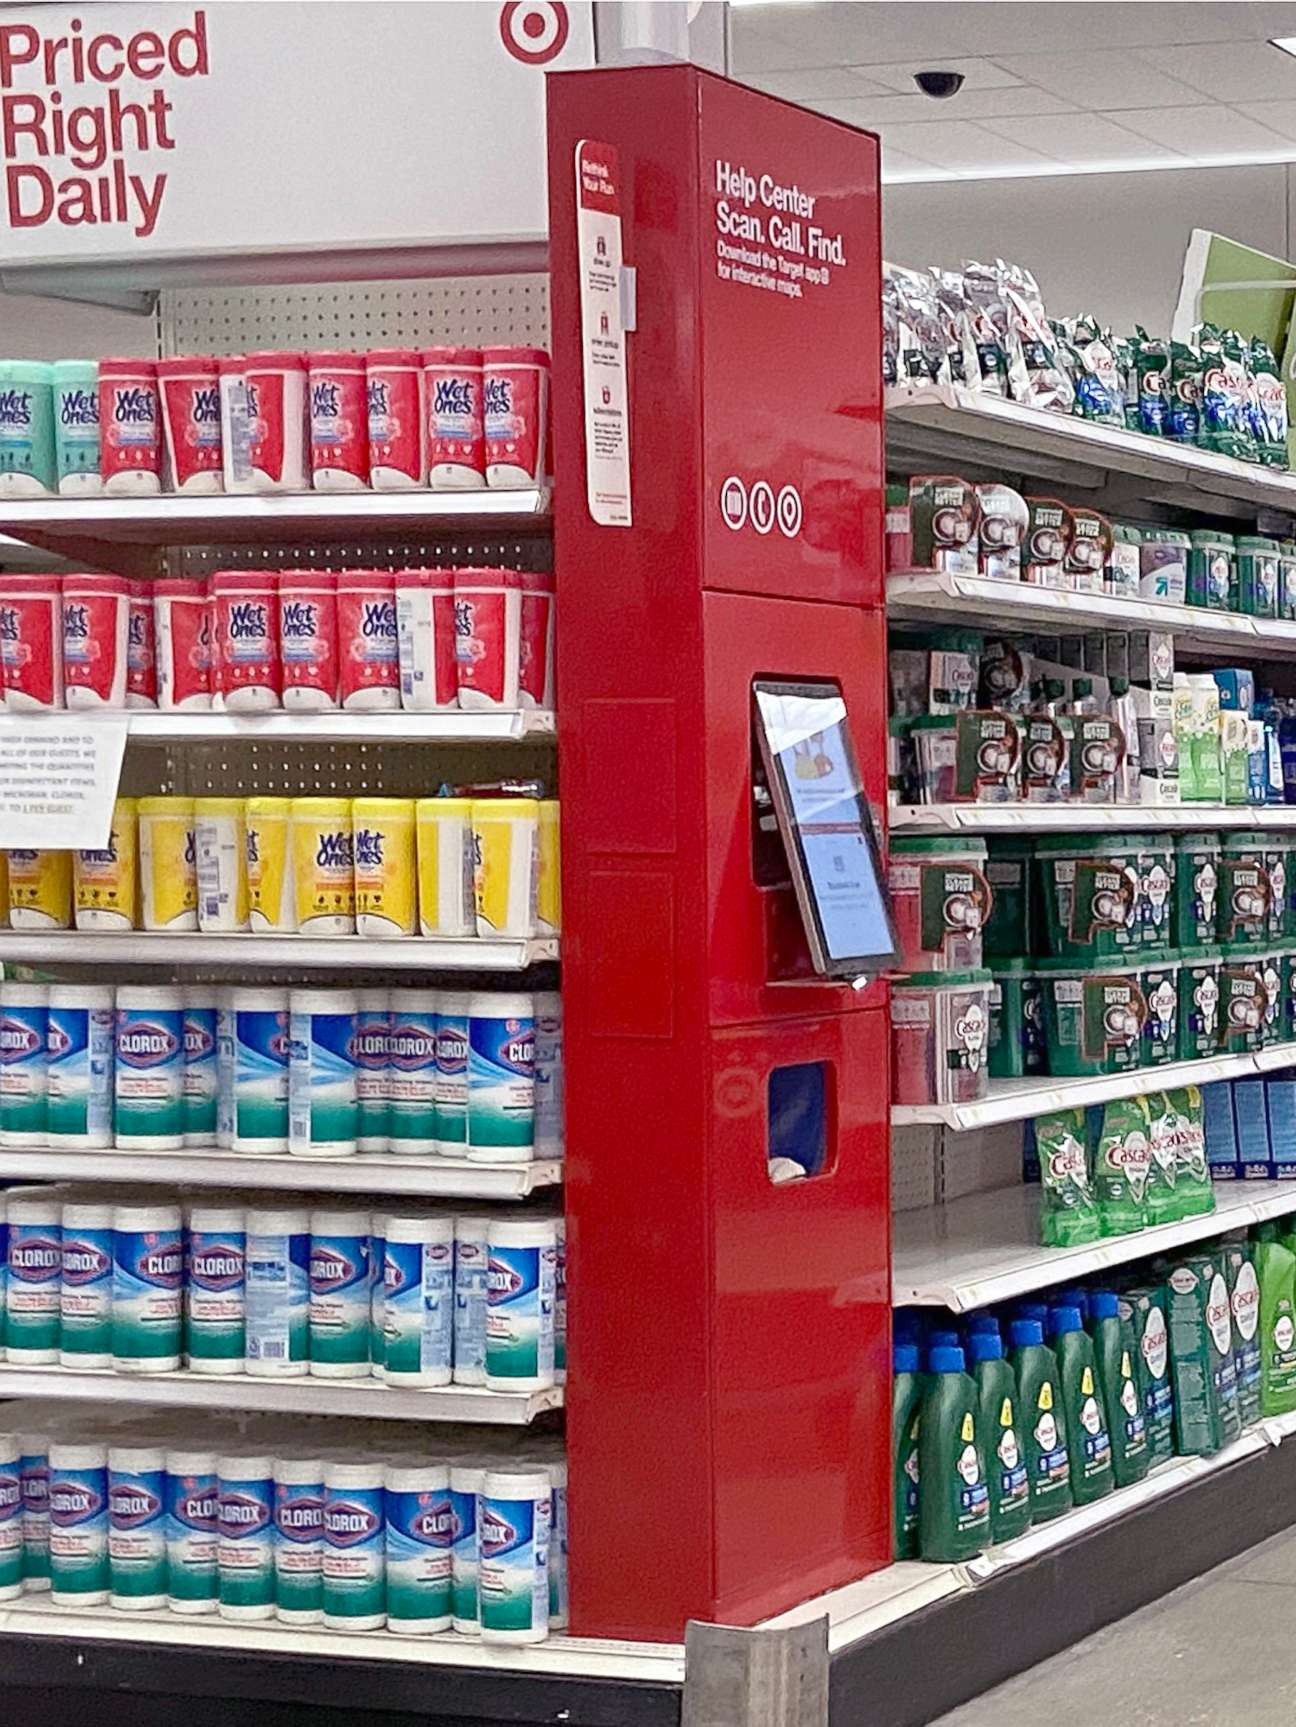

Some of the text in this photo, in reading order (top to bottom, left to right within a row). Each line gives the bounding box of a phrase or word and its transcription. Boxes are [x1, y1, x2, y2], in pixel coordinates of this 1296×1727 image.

[0, 10, 209, 88] Priced
[1, 88, 175, 171] Right
[5, 159, 167, 237] Daily
[716, 159, 815, 219] Help Center
[716, 200, 847, 266] Scan. Call. Find.
[62, 389, 98, 409] Wet
[117, 386, 154, 408] Wet
[195, 388, 220, 409] We
[436, 379, 475, 400] Wet
[61, 407, 99, 424] Ones
[116, 405, 154, 422] Ones
[193, 406, 220, 422] One
[369, 399, 388, 416] nes
[434, 398, 473, 414] Ones
[485, 398, 511, 414] nes
[232, 603, 267, 623] Wet
[283, 602, 318, 622] Wet
[364, 601, 397, 622] We
[64, 624, 88, 639] nes
[230, 621, 267, 638] Ones
[283, 620, 317, 637] Ones
[362, 620, 398, 637] One
[0, 1030, 30, 1051] ROX
[119, 1033, 170, 1053] CLOROX
[391, 1035, 434, 1056] LOROX
[509, 1042, 534, 1062] CLO
[1106, 1145, 1150, 1169] Casca
[63, 1252, 100, 1271] OROX
[148, 1255, 183, 1276] CLO
[194, 1257, 245, 1276] CLOROX
[488, 1272, 511, 1291] ROX
[51, 1495, 90, 1513] LOROX
[110, 1495, 150, 1514] LOROX
[187, 1499, 214, 1518] CLO
[281, 1507, 322, 1528] CLORO
[422, 1515, 451, 1534] CLO
[484, 1524, 507, 1543] ROX
